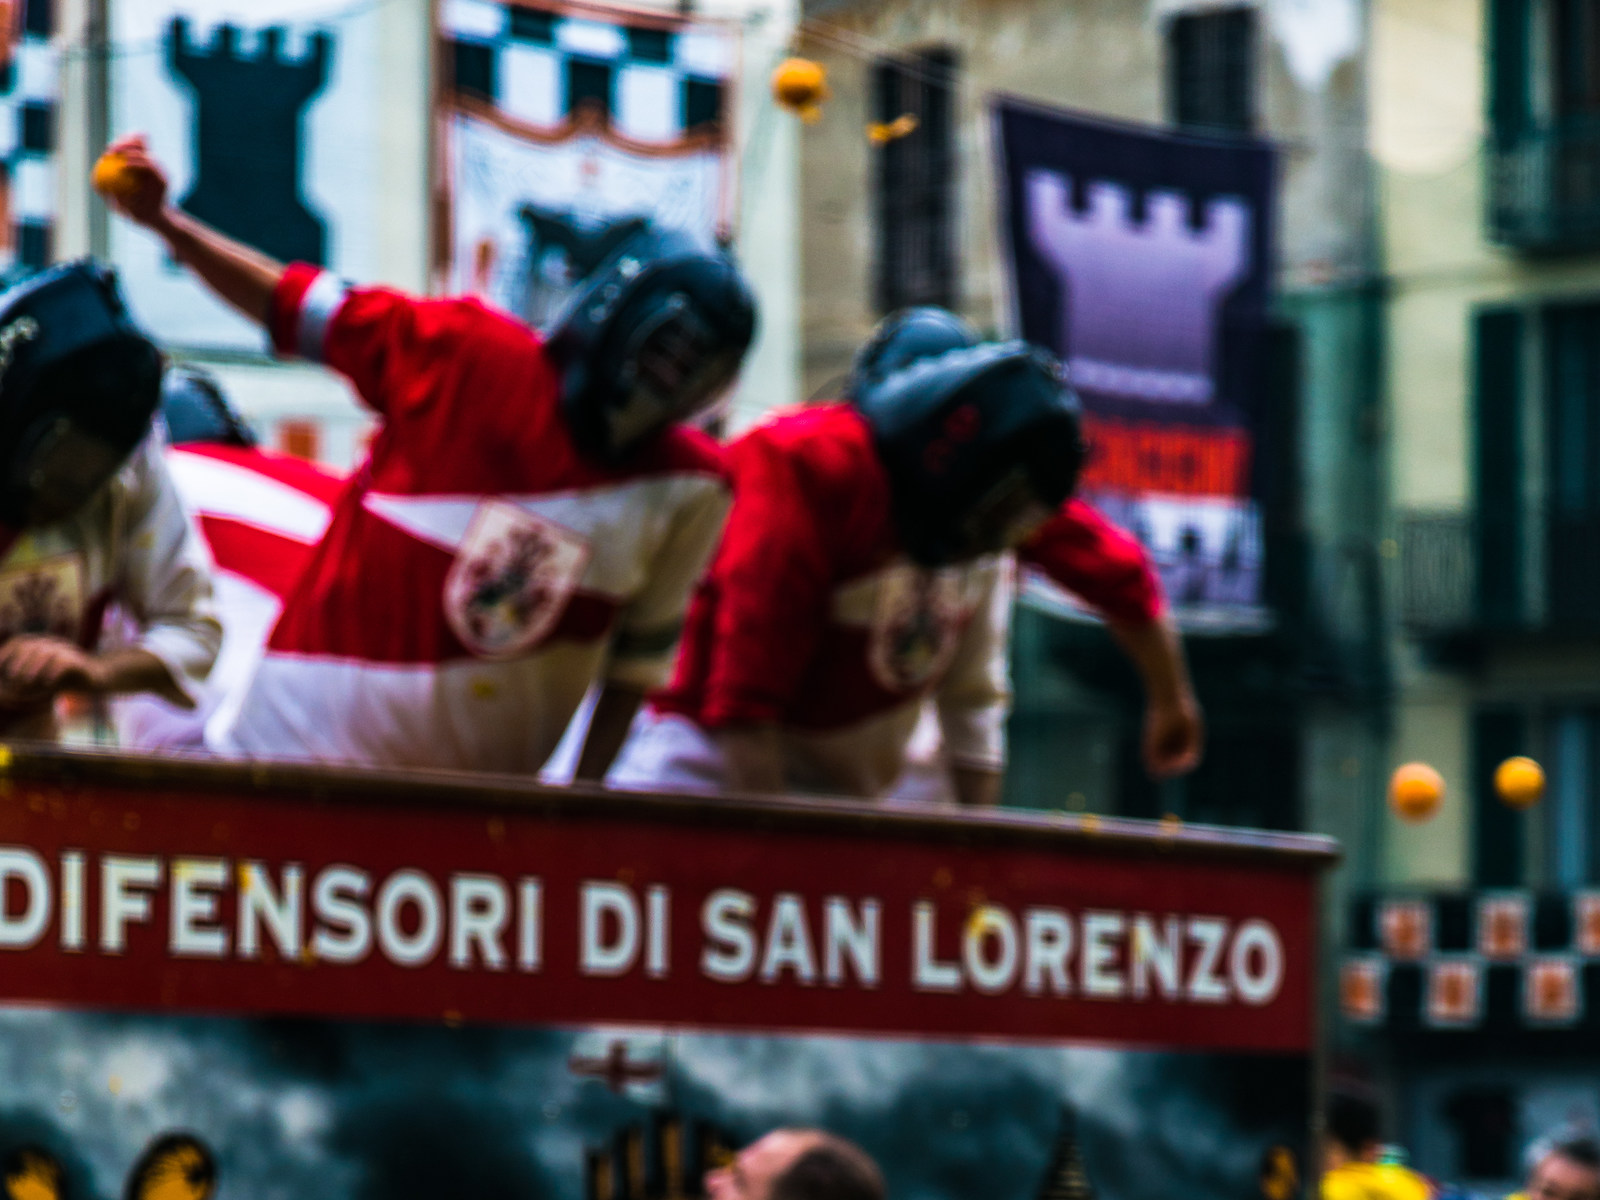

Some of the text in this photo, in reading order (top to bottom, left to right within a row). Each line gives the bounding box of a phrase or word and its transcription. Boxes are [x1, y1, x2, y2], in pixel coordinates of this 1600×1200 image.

[0, 847, 1284, 1002] DIFENSORI DI SAN LORENZO
